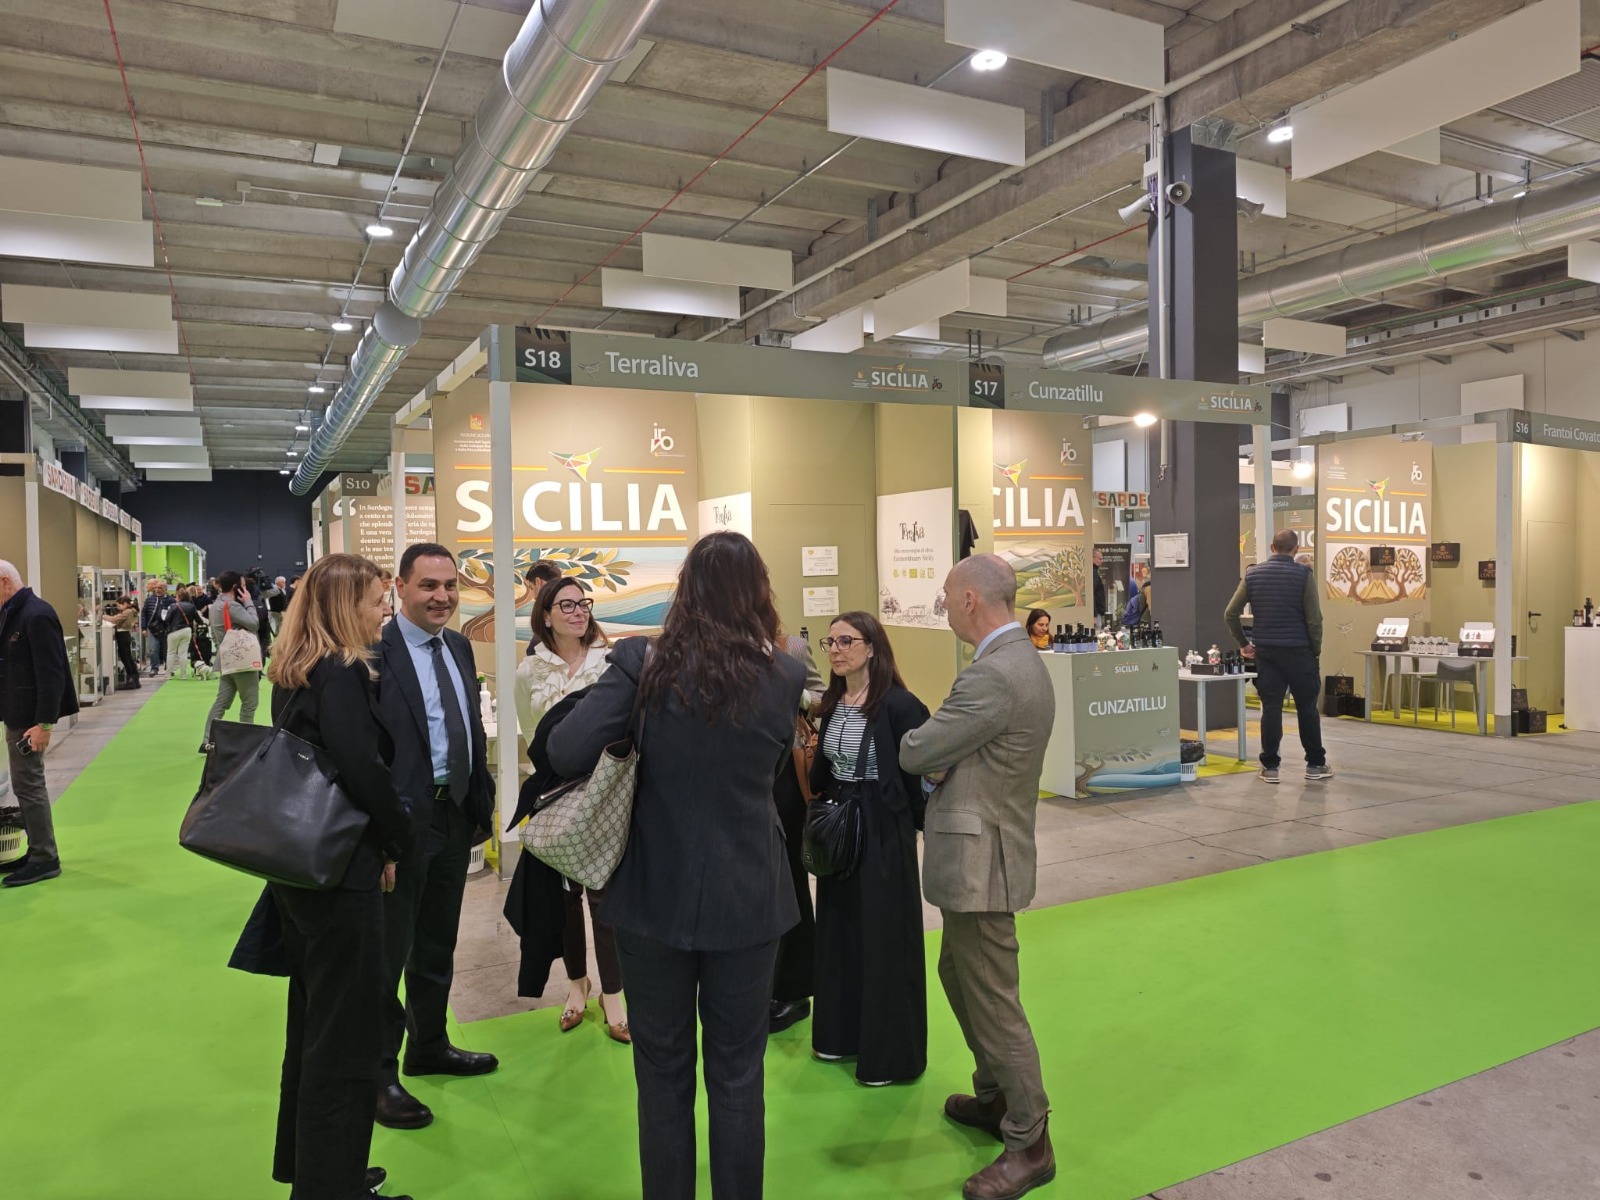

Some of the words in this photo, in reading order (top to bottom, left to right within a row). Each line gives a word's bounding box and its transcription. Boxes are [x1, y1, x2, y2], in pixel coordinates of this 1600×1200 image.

[525, 349, 561, 369] S18
[604, 351, 699, 378] Terraliva
[871, 371, 929, 388] SICILIA
[974, 380, 998, 396] S17
[1028, 381, 1104, 403] Cunzatillu
[1210, 396, 1252, 411] SICILIA
[1515, 421, 1529, 434] S16
[1543, 423, 1573, 440] Frantoi
[346, 477, 371, 489] S10
[404, 475, 435, 494] SA
[455, 480, 688, 532] SCILIA
[1097, 492, 1150, 507] SARDE
[1325, 497, 1427, 535] SICILIA
[1114, 665, 1139, 674] SICILIA
[1088, 695, 1167, 717] CUNZATILLU
